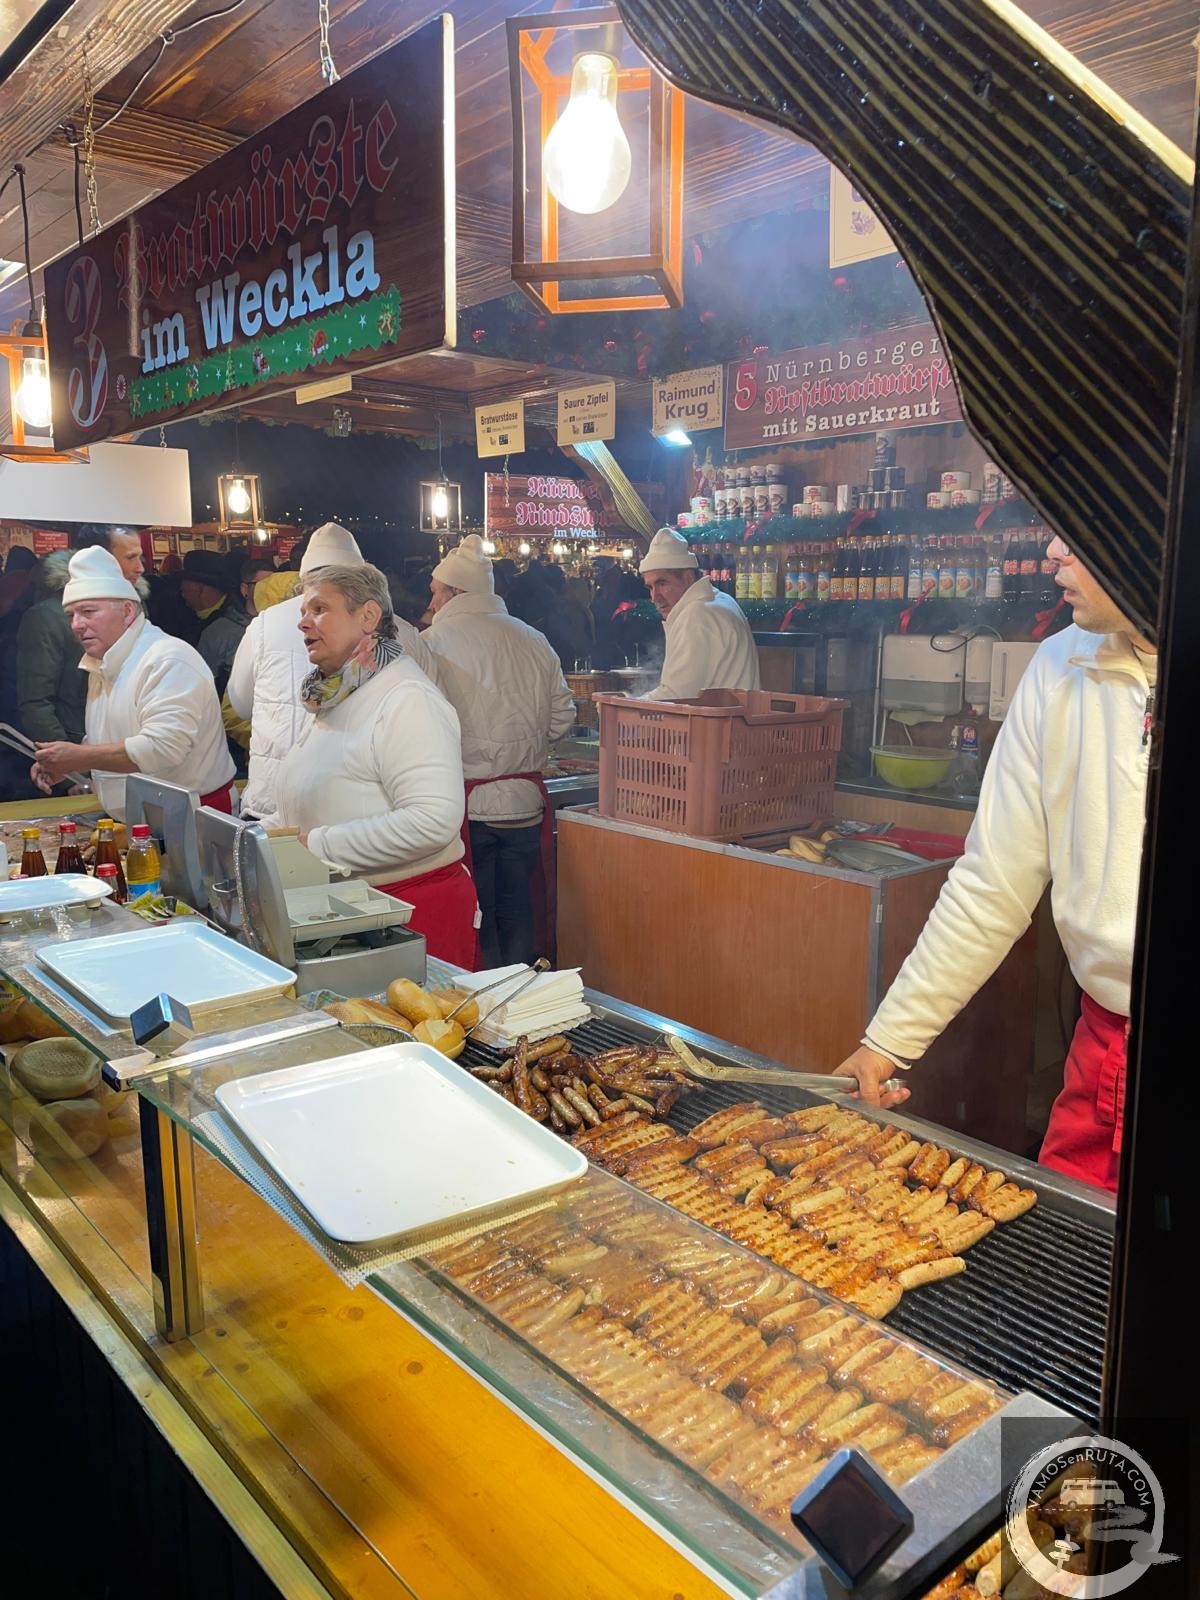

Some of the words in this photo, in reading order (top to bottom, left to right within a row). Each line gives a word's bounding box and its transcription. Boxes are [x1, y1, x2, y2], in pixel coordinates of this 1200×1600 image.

[64, 256, 108, 431] 3
[114, 98, 399, 312] Bratwürste
[140, 309, 189, 373] im
[196, 225, 380, 350] Weckla
[563, 397, 585, 410] Saure
[586, 391, 609, 407] Zipfel
[658, 379, 716, 403] Raimund
[734, 362, 757, 412] 5
[665, 400, 709, 420] Krug
[762, 419, 798, 438] mit
[805, 397, 940, 433] Sauerkraut
[554, 527, 567, 538] im
